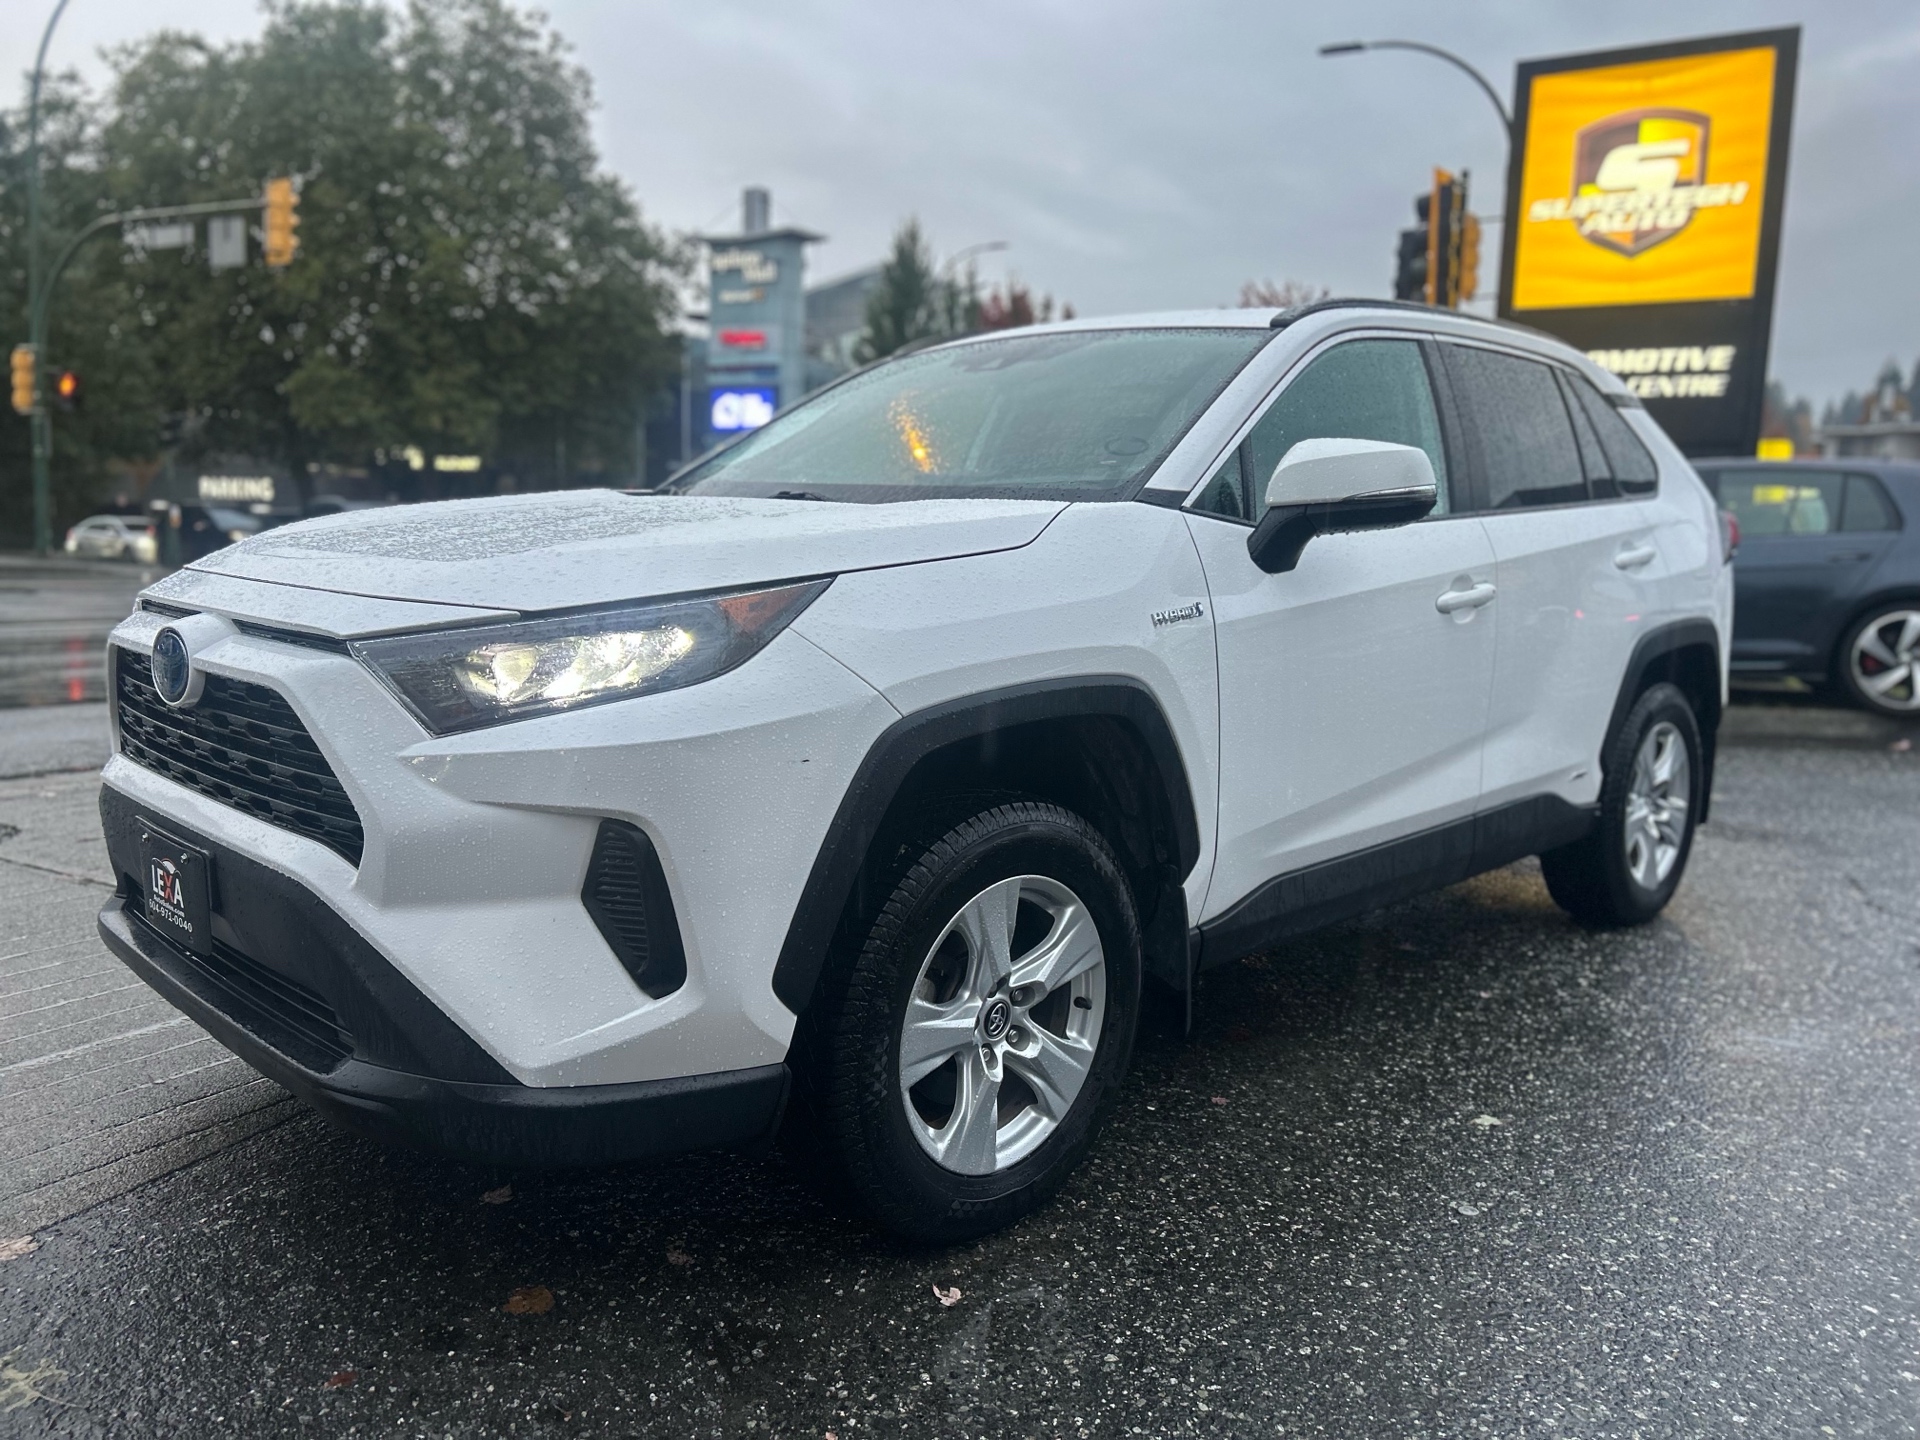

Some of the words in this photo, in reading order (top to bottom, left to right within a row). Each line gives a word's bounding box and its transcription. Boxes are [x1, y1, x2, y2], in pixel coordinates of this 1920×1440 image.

[1529, 181, 1750, 222] SUPERTECH
[1580, 209, 1690, 235] AUTO
[1626, 374, 1730, 399] CENTRE
[198, 475, 275, 503] PARKING
[1151, 605, 1197, 628] HYBRID
[151, 864, 185, 909] LEXA
[148, 898, 193, 933] 604-971-0040
